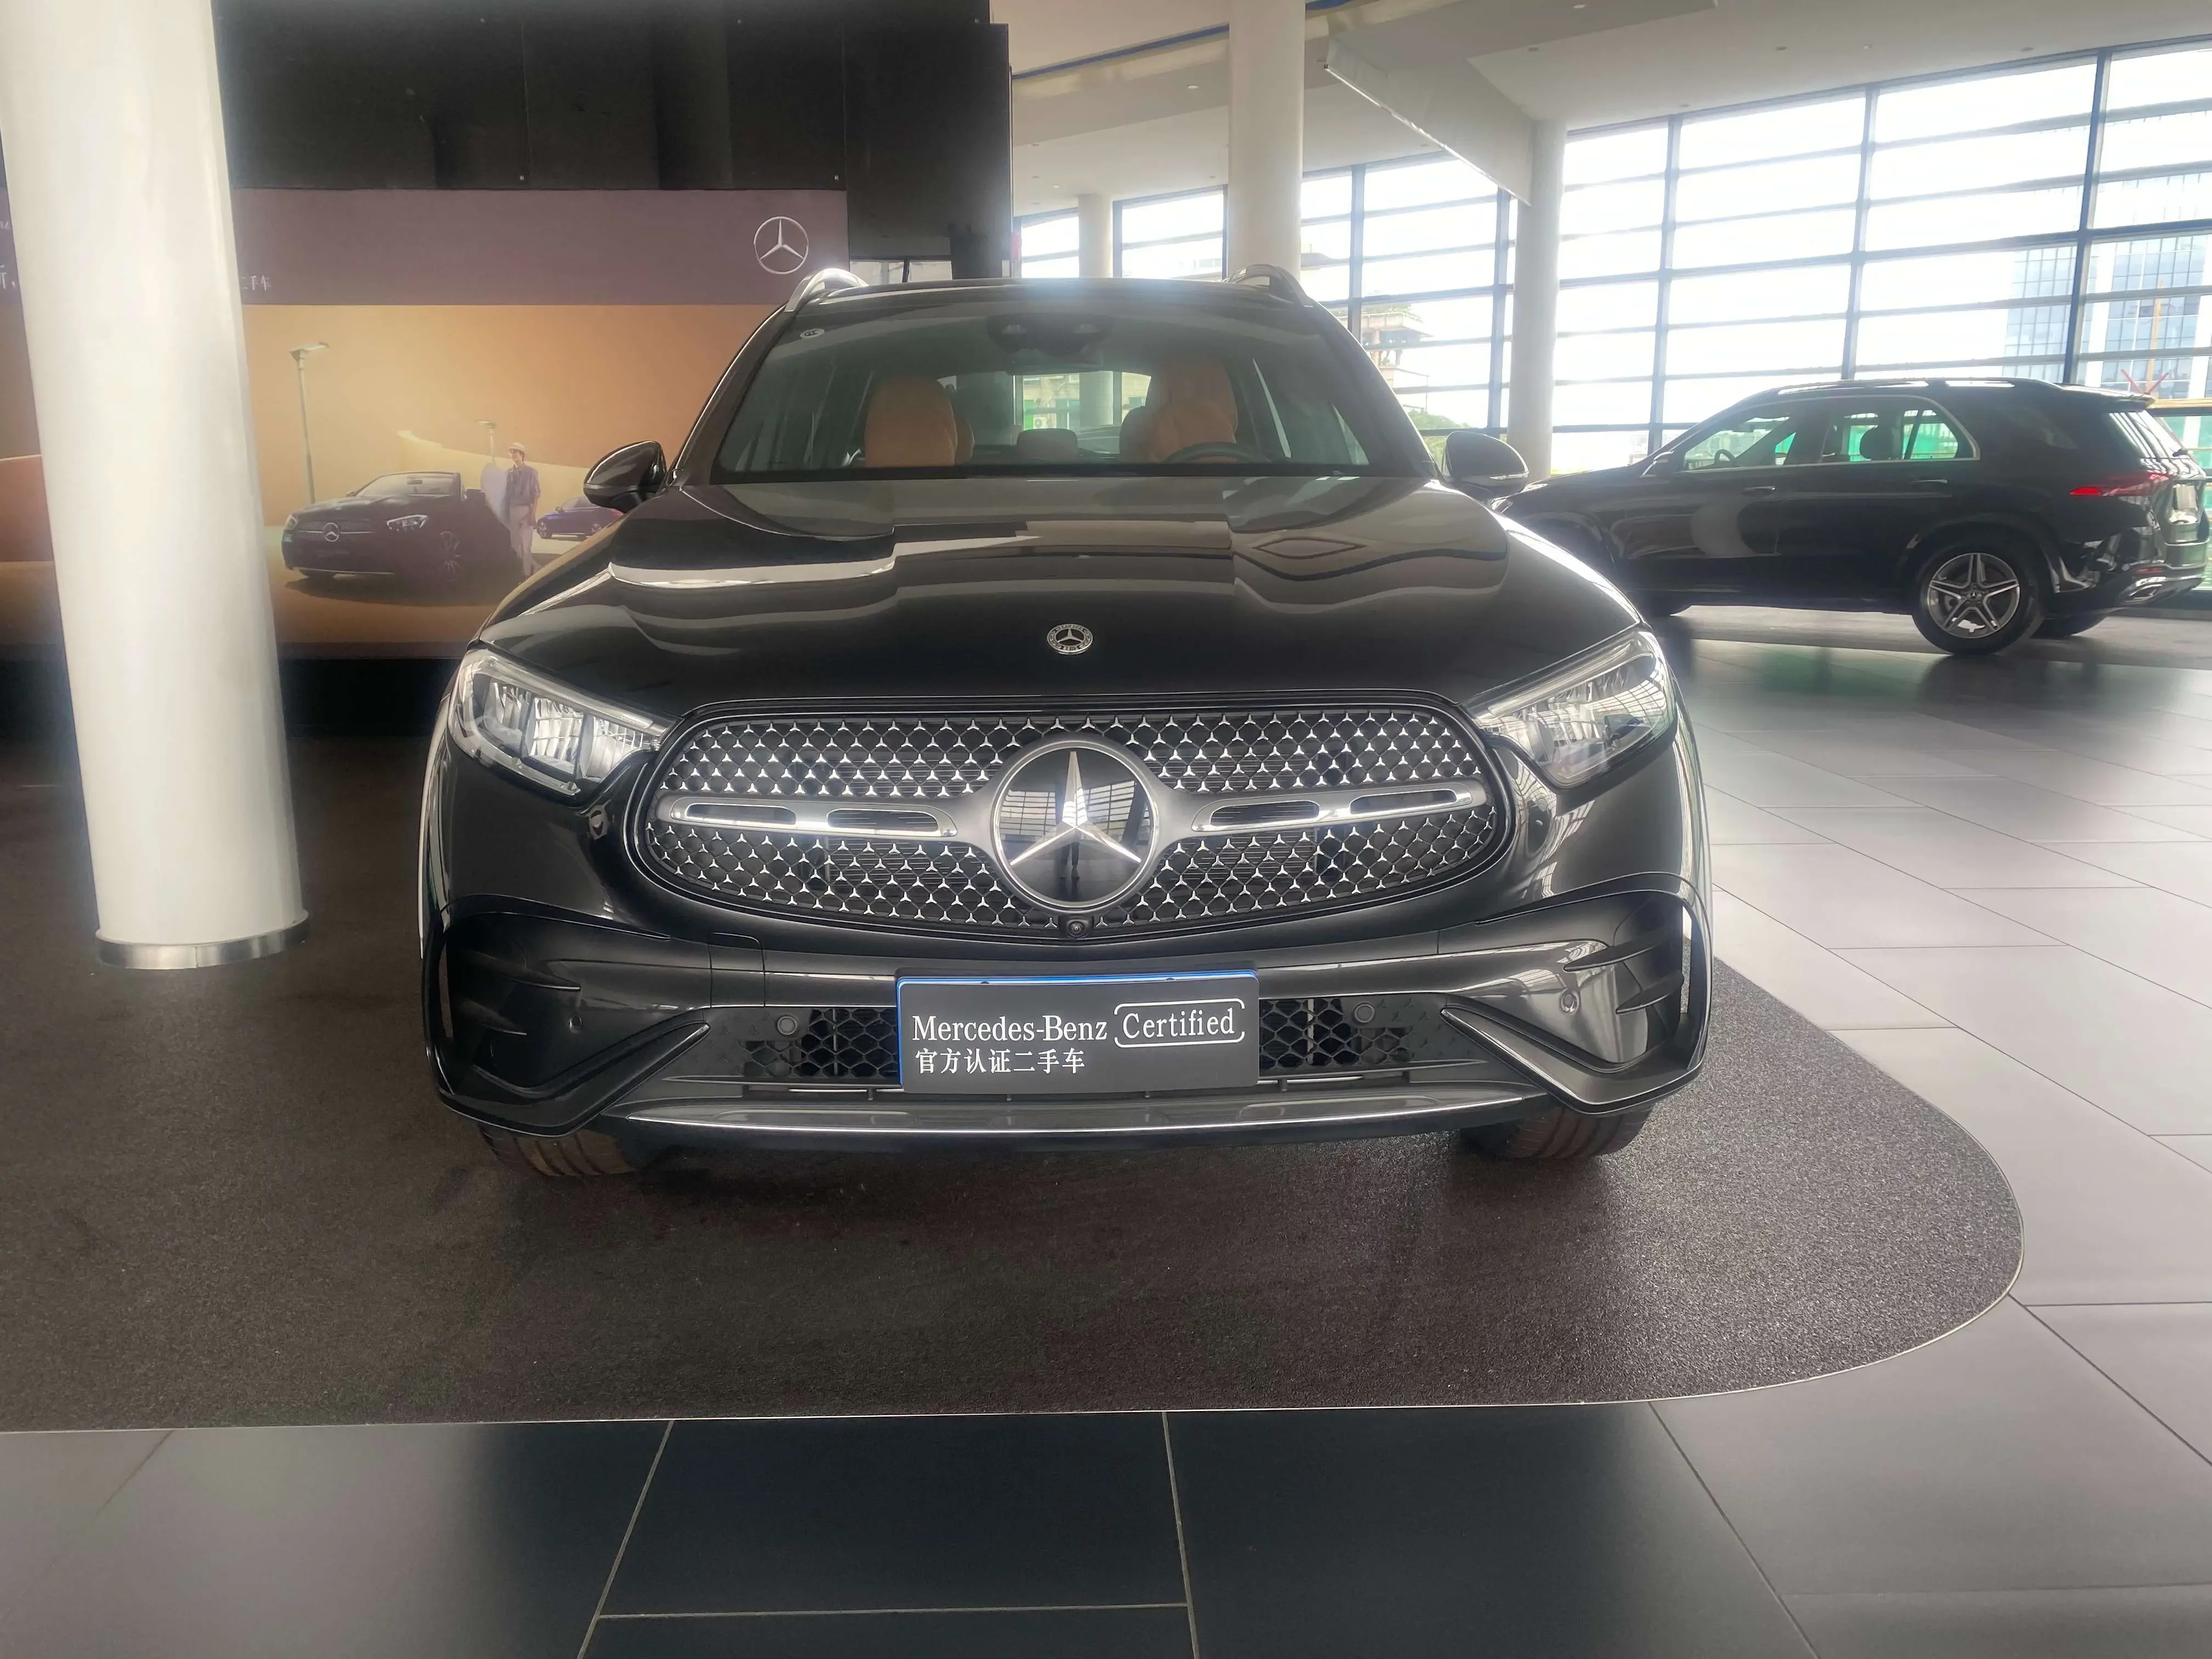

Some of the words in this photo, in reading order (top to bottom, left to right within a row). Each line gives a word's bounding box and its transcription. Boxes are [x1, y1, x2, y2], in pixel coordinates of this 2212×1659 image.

[912, 1014, 1108, 1041] Mercedes-Benz
[1122, 1007, 1235, 1040] Certified
[915, 1047, 1086, 1075] 官方认证二手车
